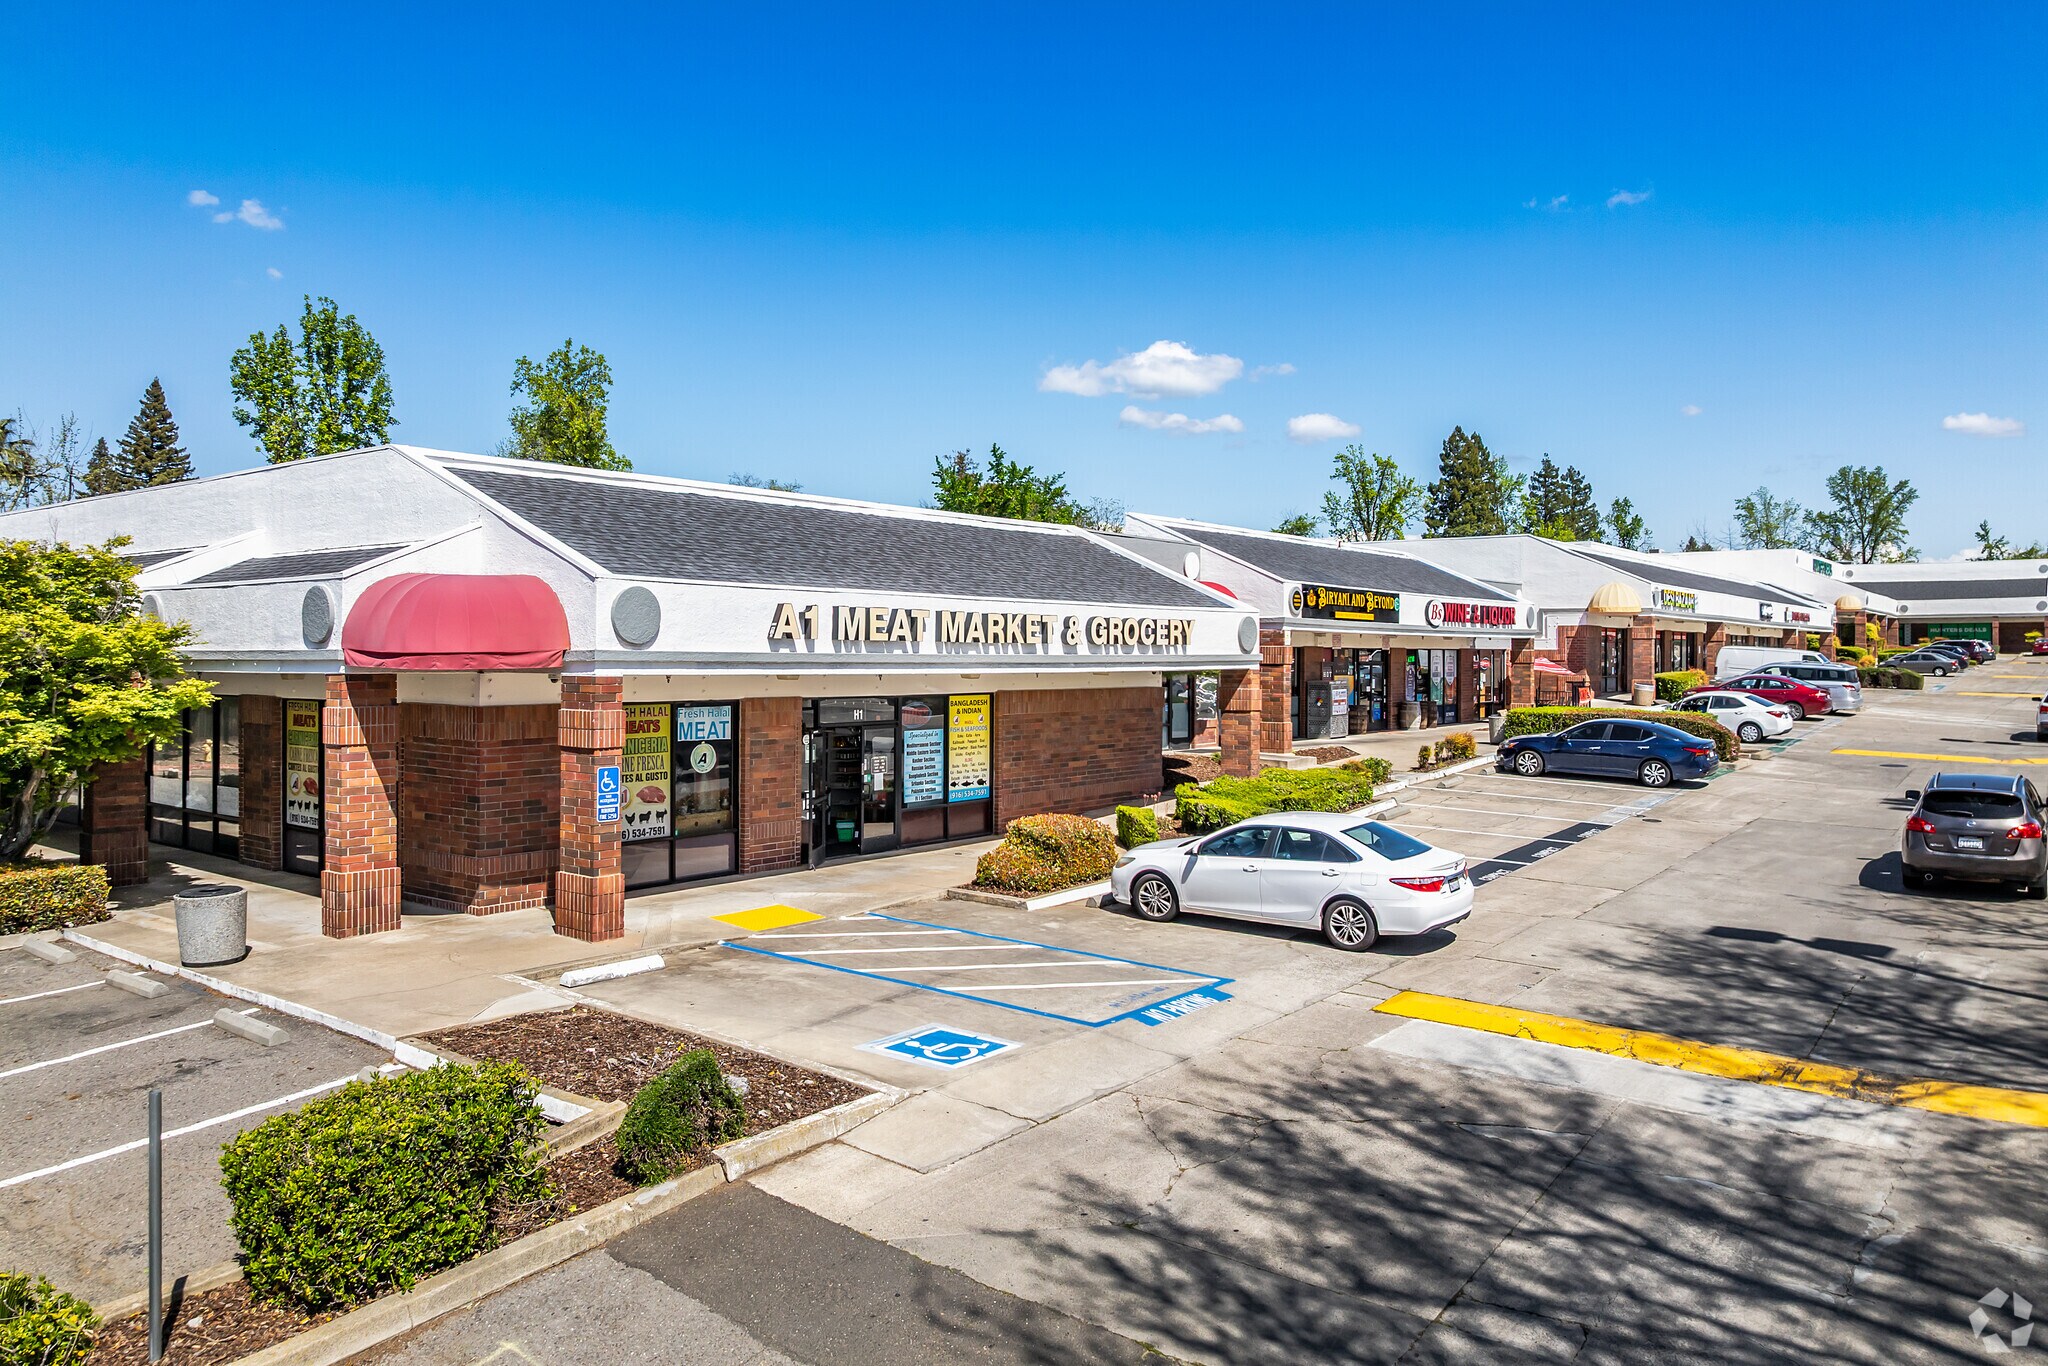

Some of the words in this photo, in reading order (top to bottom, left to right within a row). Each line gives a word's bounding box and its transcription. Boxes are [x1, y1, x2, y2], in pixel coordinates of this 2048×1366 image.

[1318, 587, 1351, 609] BIRYANI
[1351, 592, 1366, 607] AND
[1366, 592, 1395, 612] BEYOND
[1443, 603, 1471, 623] WINE
[1472, 604, 1480, 624] &
[1481, 606, 1516, 626] LIQUOR
[769, 602, 819, 640] A1
[832, 605, 931, 642] MEAT
[936, 610, 1058, 644] MARKET
[1063, 615, 1082, 646] &
[1086, 616, 1196, 646] GROCERY
[304, 702, 318, 712] HALA
[950, 699, 988, 707] BANGLADESH
[639, 706, 669, 718] HALAL
[678, 708, 705, 719] Fresh
[707, 706, 730, 718] Halal
[853, 709, 863, 720] H1
[293, 713, 317, 728] MEATS
[678, 720, 730, 740] MEAT
[635, 773, 644, 783] AL
[645, 771, 668, 782] GUSTO
[631, 825, 665, 839] 534-7591
[1141, 1007, 1177, 1024] NO
[1159, 993, 1220, 1018] PARKING
